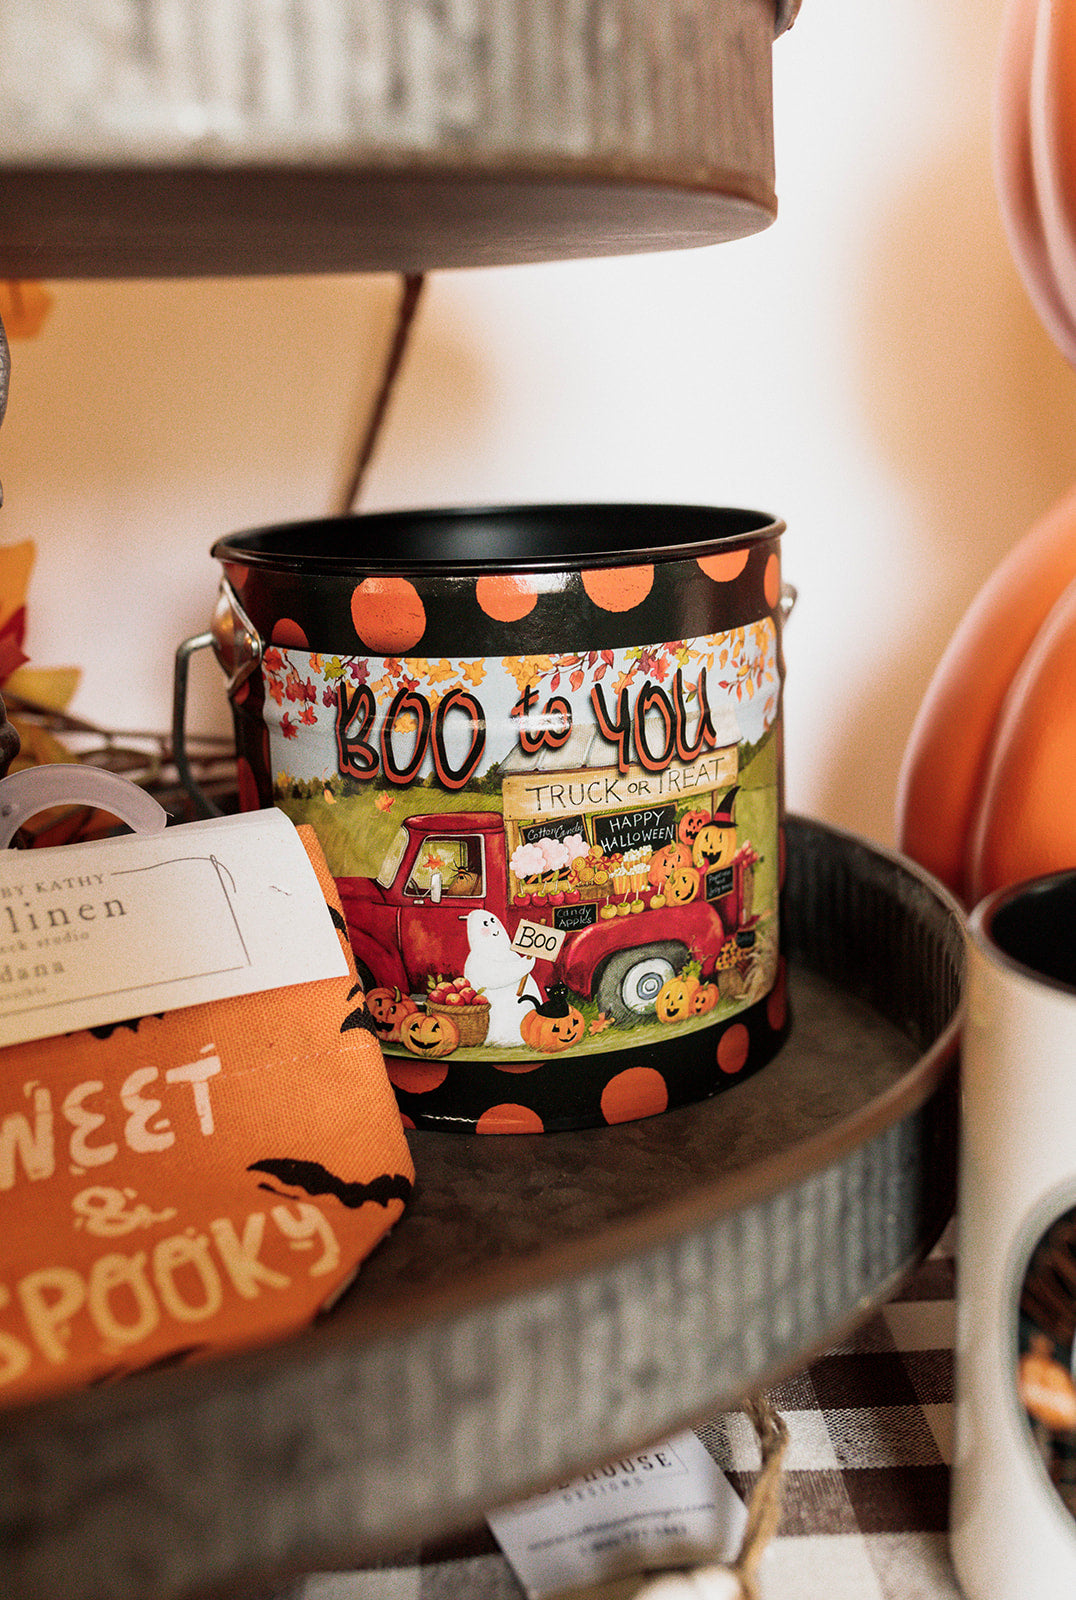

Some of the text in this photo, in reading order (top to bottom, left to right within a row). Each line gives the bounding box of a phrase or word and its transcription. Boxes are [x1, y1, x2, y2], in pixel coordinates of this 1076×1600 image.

[336, 666, 718, 789] BOO to YOU
[525, 757, 725, 811] TRUCK OR TREAT
[609, 810, 665, 833] HAPPY
[600, 824, 675, 853] HALLOWEEN
[36, 873, 104, 894] KATHY
[5, 899, 127, 933] linen
[556, 905, 592, 921] Candy
[72, 1185, 178, 1238] &
